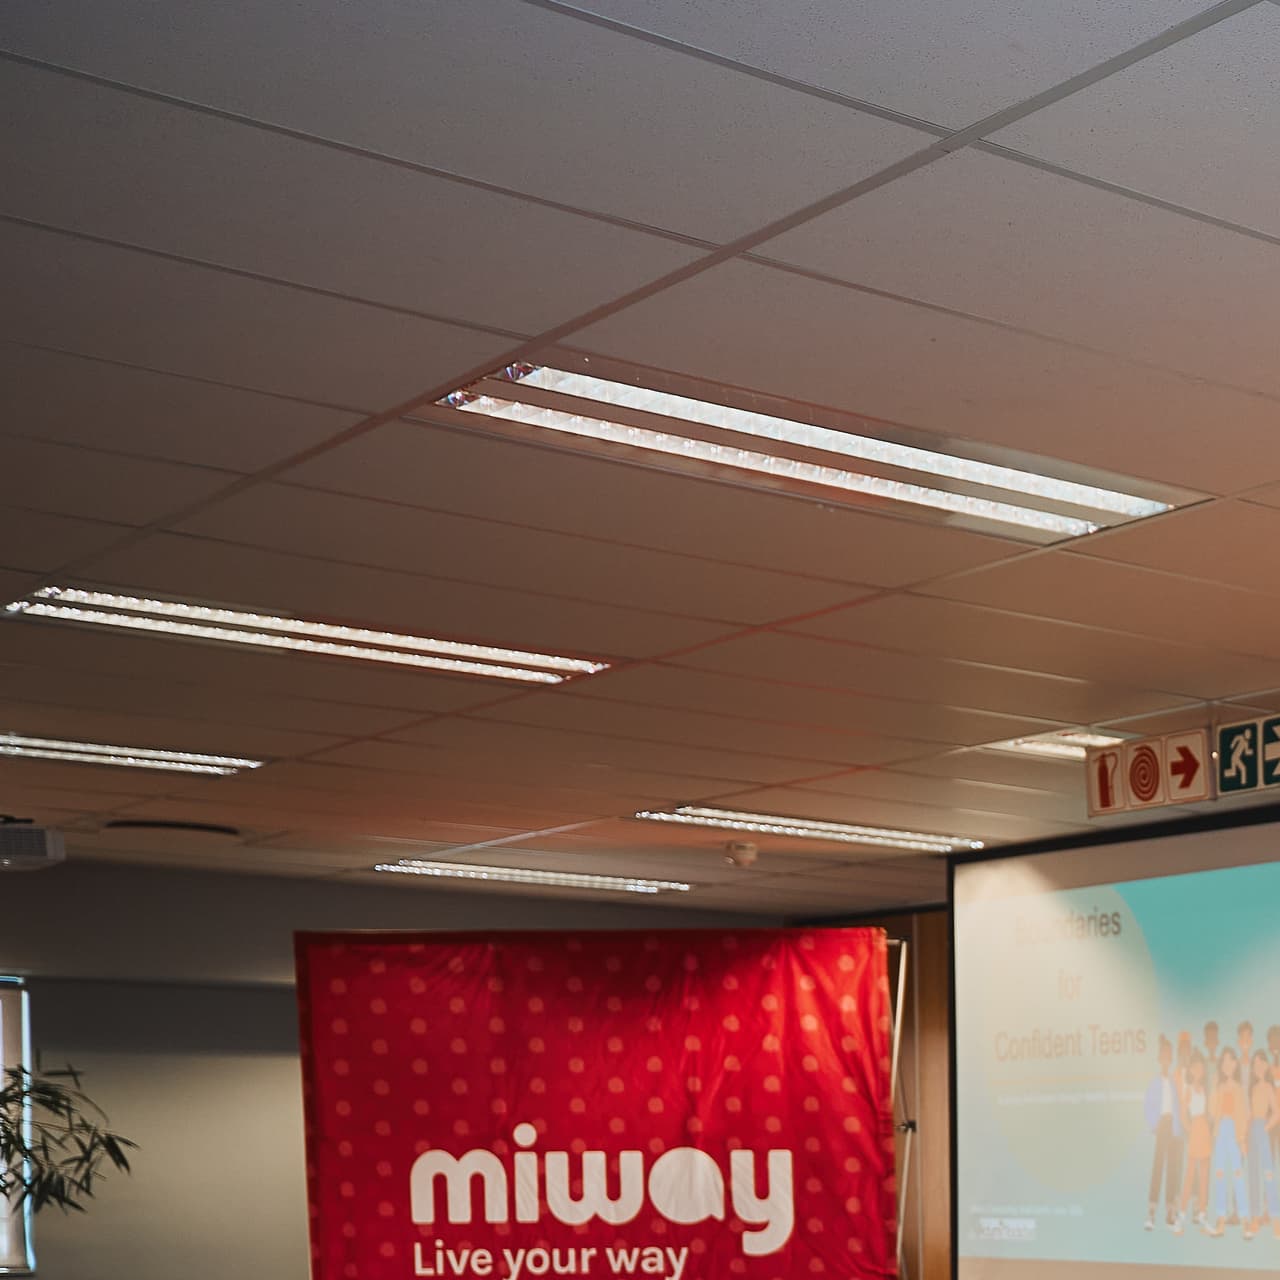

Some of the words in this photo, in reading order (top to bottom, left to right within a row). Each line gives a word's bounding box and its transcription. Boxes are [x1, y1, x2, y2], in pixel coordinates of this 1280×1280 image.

[994, 1028, 1083, 1063] Confident
[1088, 1023, 1147, 1056] Teens
[410, 1123, 795, 1257] miway
[414, 1239, 493, 1277] Live
